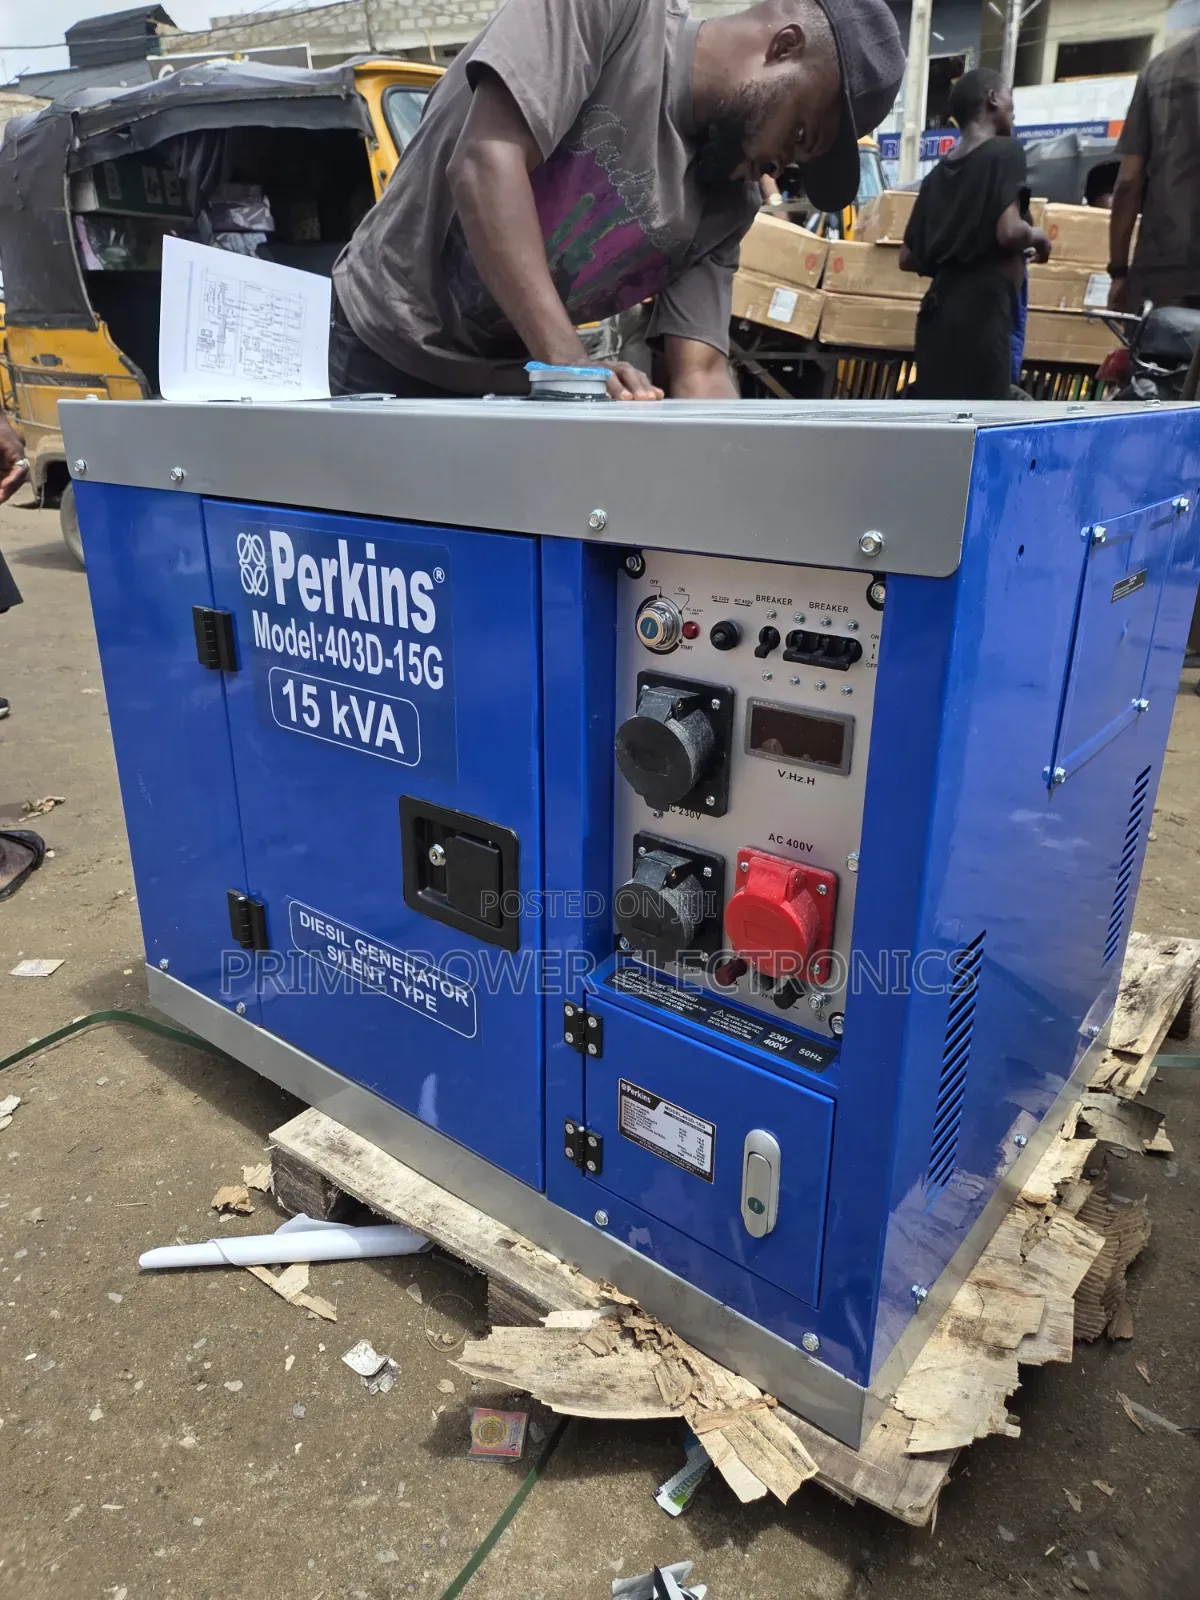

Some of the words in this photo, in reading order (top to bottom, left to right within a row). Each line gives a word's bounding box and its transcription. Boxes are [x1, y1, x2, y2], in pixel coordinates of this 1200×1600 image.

[756, 594, 793, 606] BREAKER
[809, 601, 849, 613] BREAKER
[252, 609, 444, 690] Model:403D-15G
[282, 678, 321, 728] 15
[330, 690, 405, 754] kVA
[777, 769, 816, 786] V.Hz.H
[768, 833, 784, 845] AC
[786, 838, 814, 853] 400V
[299, 910, 351, 949] DIESIL
[354, 938, 470, 1008] GENERATOR
[326, 944, 386, 985] SILENT
[389, 974, 438, 1013] TYPE
[763, 1039, 787, 1051] 400V
[768, 1032, 793, 1044] 230V
[798, 1048, 824, 1062] 50Hz
[627, 1085, 651, 1103] Perkins
